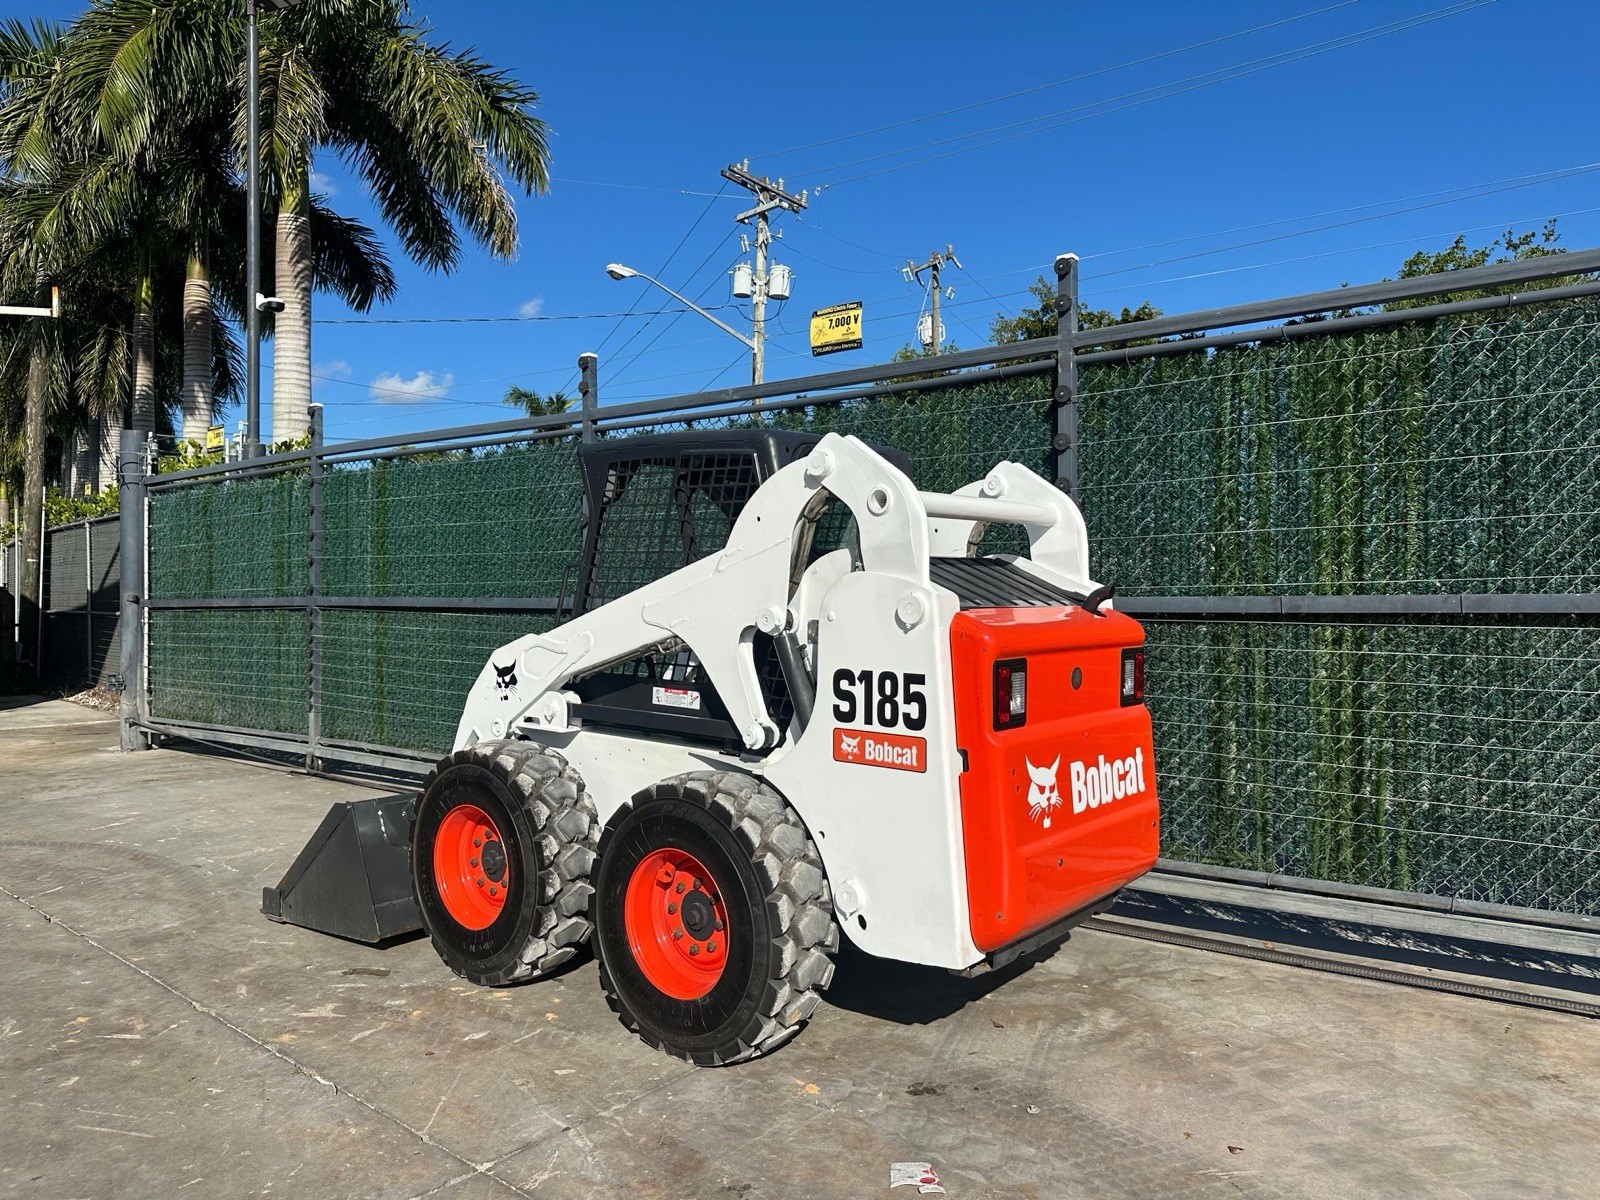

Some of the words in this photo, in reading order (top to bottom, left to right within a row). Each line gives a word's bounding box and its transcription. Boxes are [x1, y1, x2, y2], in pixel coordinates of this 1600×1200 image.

[828, 316, 851, 329] 7,000
[853, 314, 859, 324] V
[832, 668, 927, 731] S185
[864, 739, 918, 766] Bobcat
[1070, 746, 1145, 815] Bobcat
